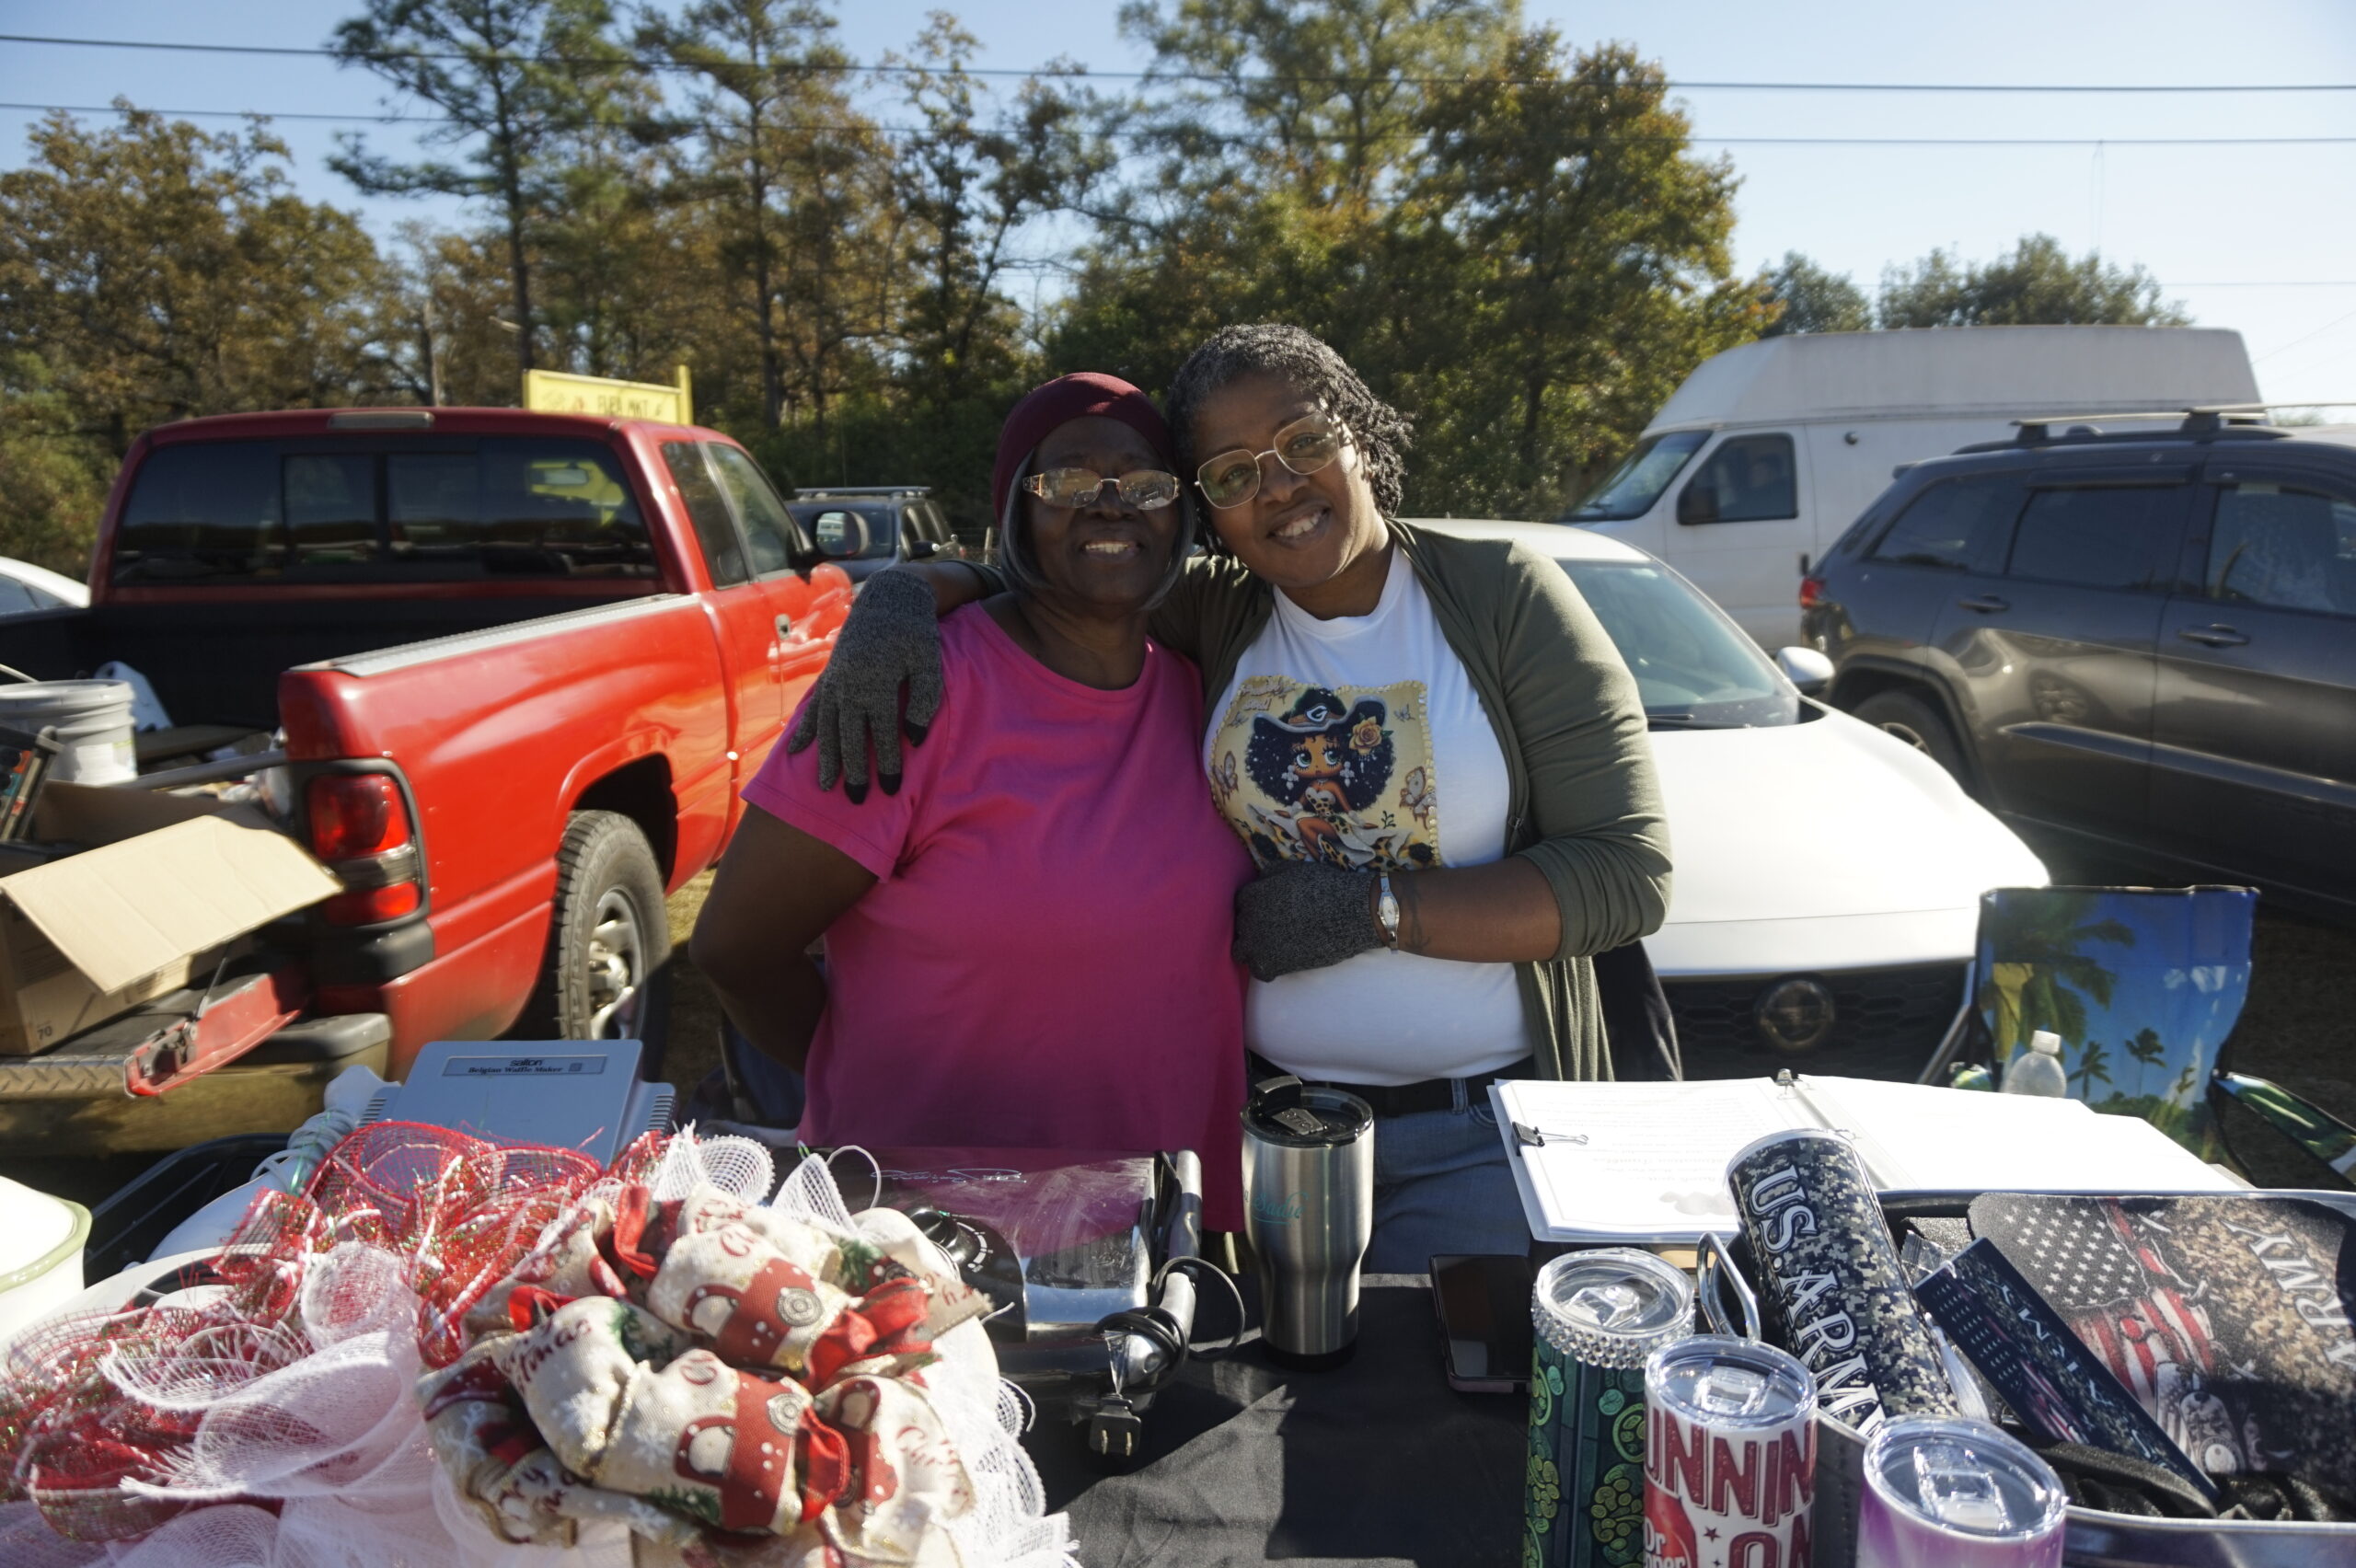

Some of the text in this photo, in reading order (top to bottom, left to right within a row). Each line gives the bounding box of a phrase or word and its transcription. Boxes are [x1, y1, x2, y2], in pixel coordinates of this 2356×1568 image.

[37, 1026, 52, 1040] 70
[509, 1058, 544, 1066] salton
[468, 1066, 502, 1076] Belgian
